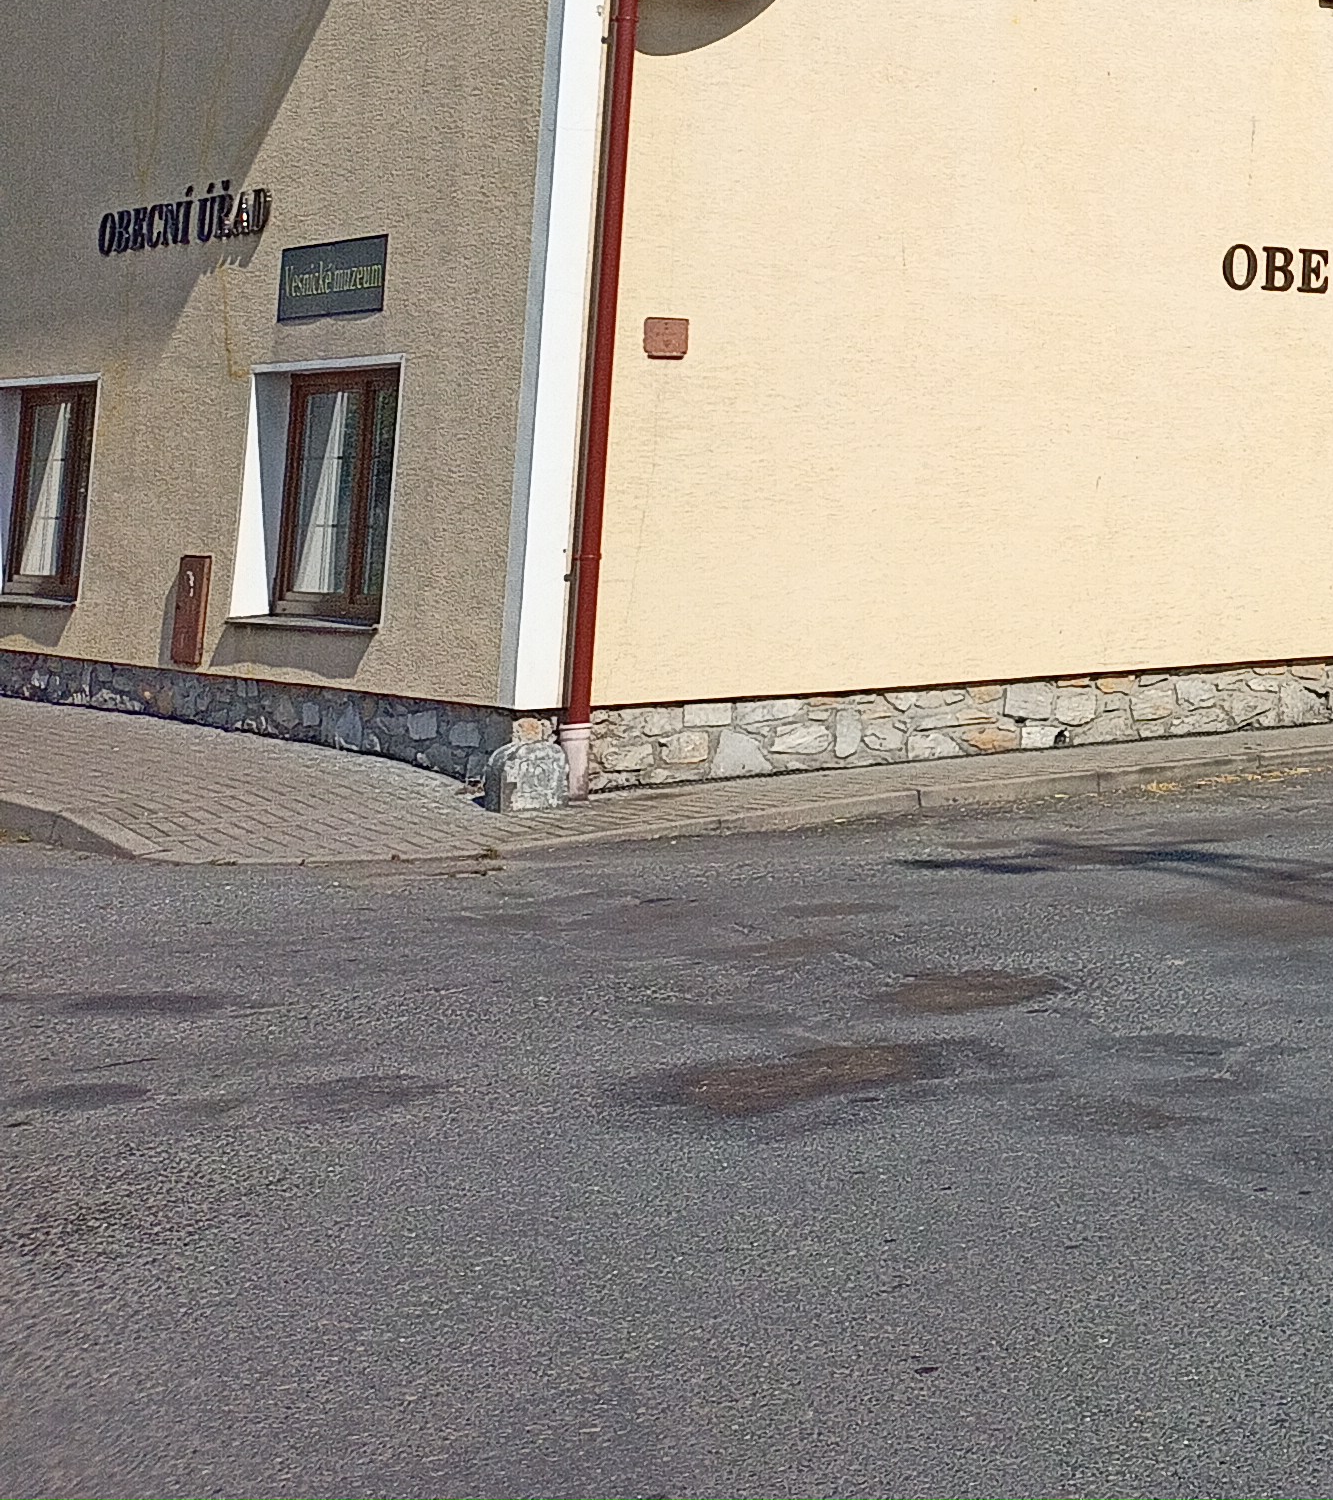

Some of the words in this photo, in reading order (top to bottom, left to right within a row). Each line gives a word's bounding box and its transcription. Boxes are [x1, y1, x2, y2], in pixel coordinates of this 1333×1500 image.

[98, 185, 193, 257] OBECNÍ
[197, 179, 273, 243] ÚŘAD
[285, 261, 333, 297] Vesnické
[333, 264, 383, 292] muzeum
